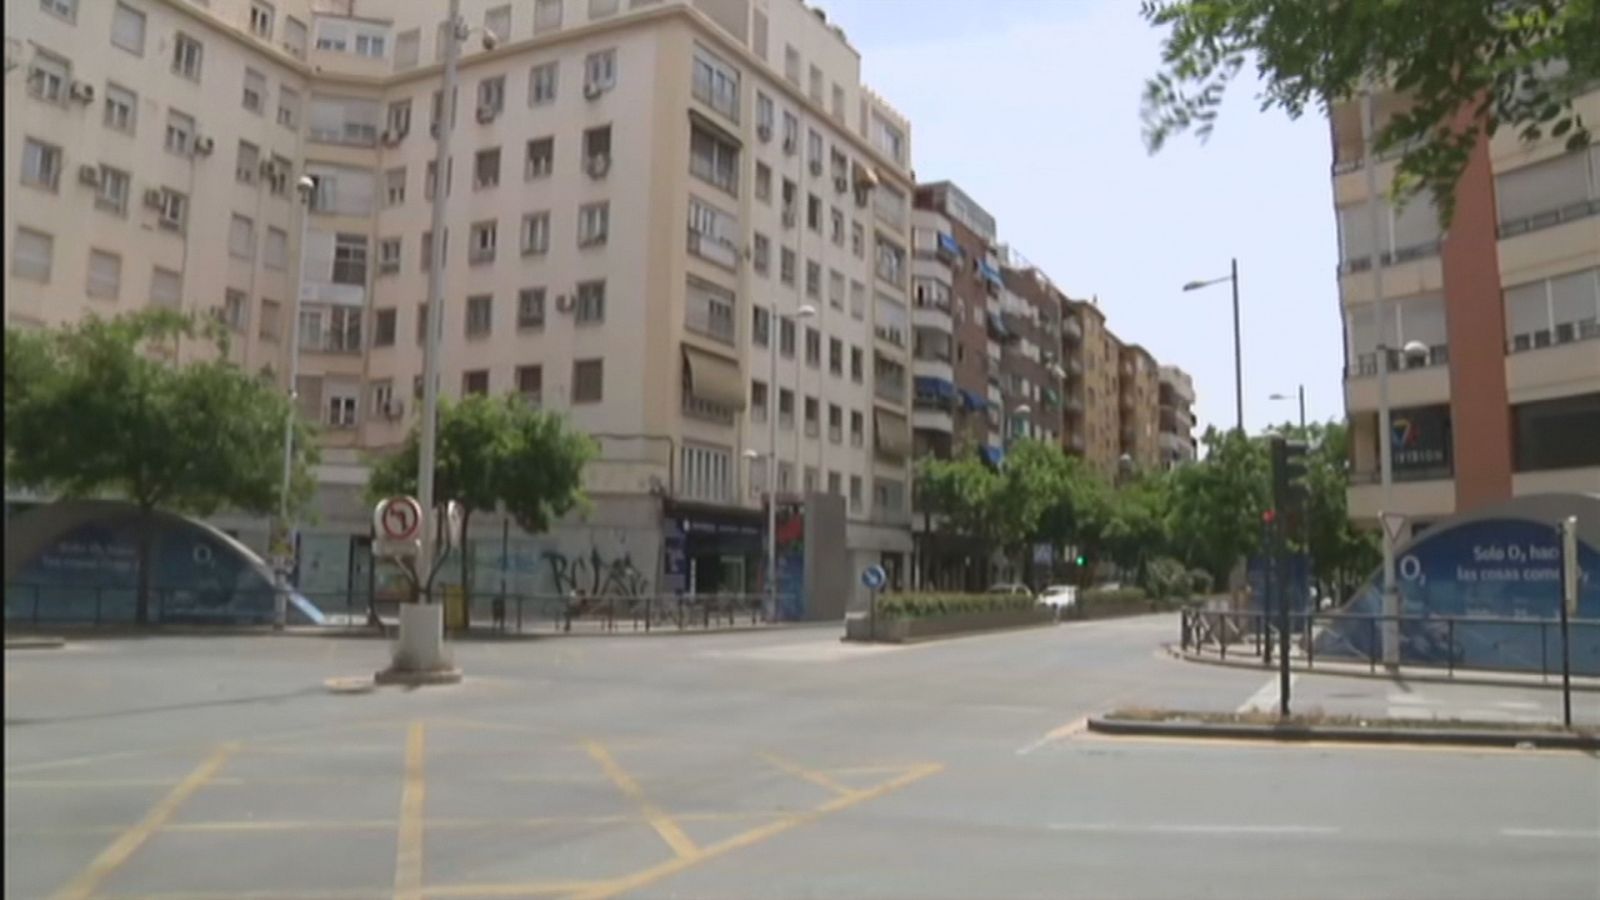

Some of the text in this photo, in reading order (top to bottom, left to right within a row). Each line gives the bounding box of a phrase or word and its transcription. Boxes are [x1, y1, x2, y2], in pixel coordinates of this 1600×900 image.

[1473, 544, 1505, 561] Solo
[1456, 564, 1477, 581] las
[1480, 568, 1519, 581] cosas
